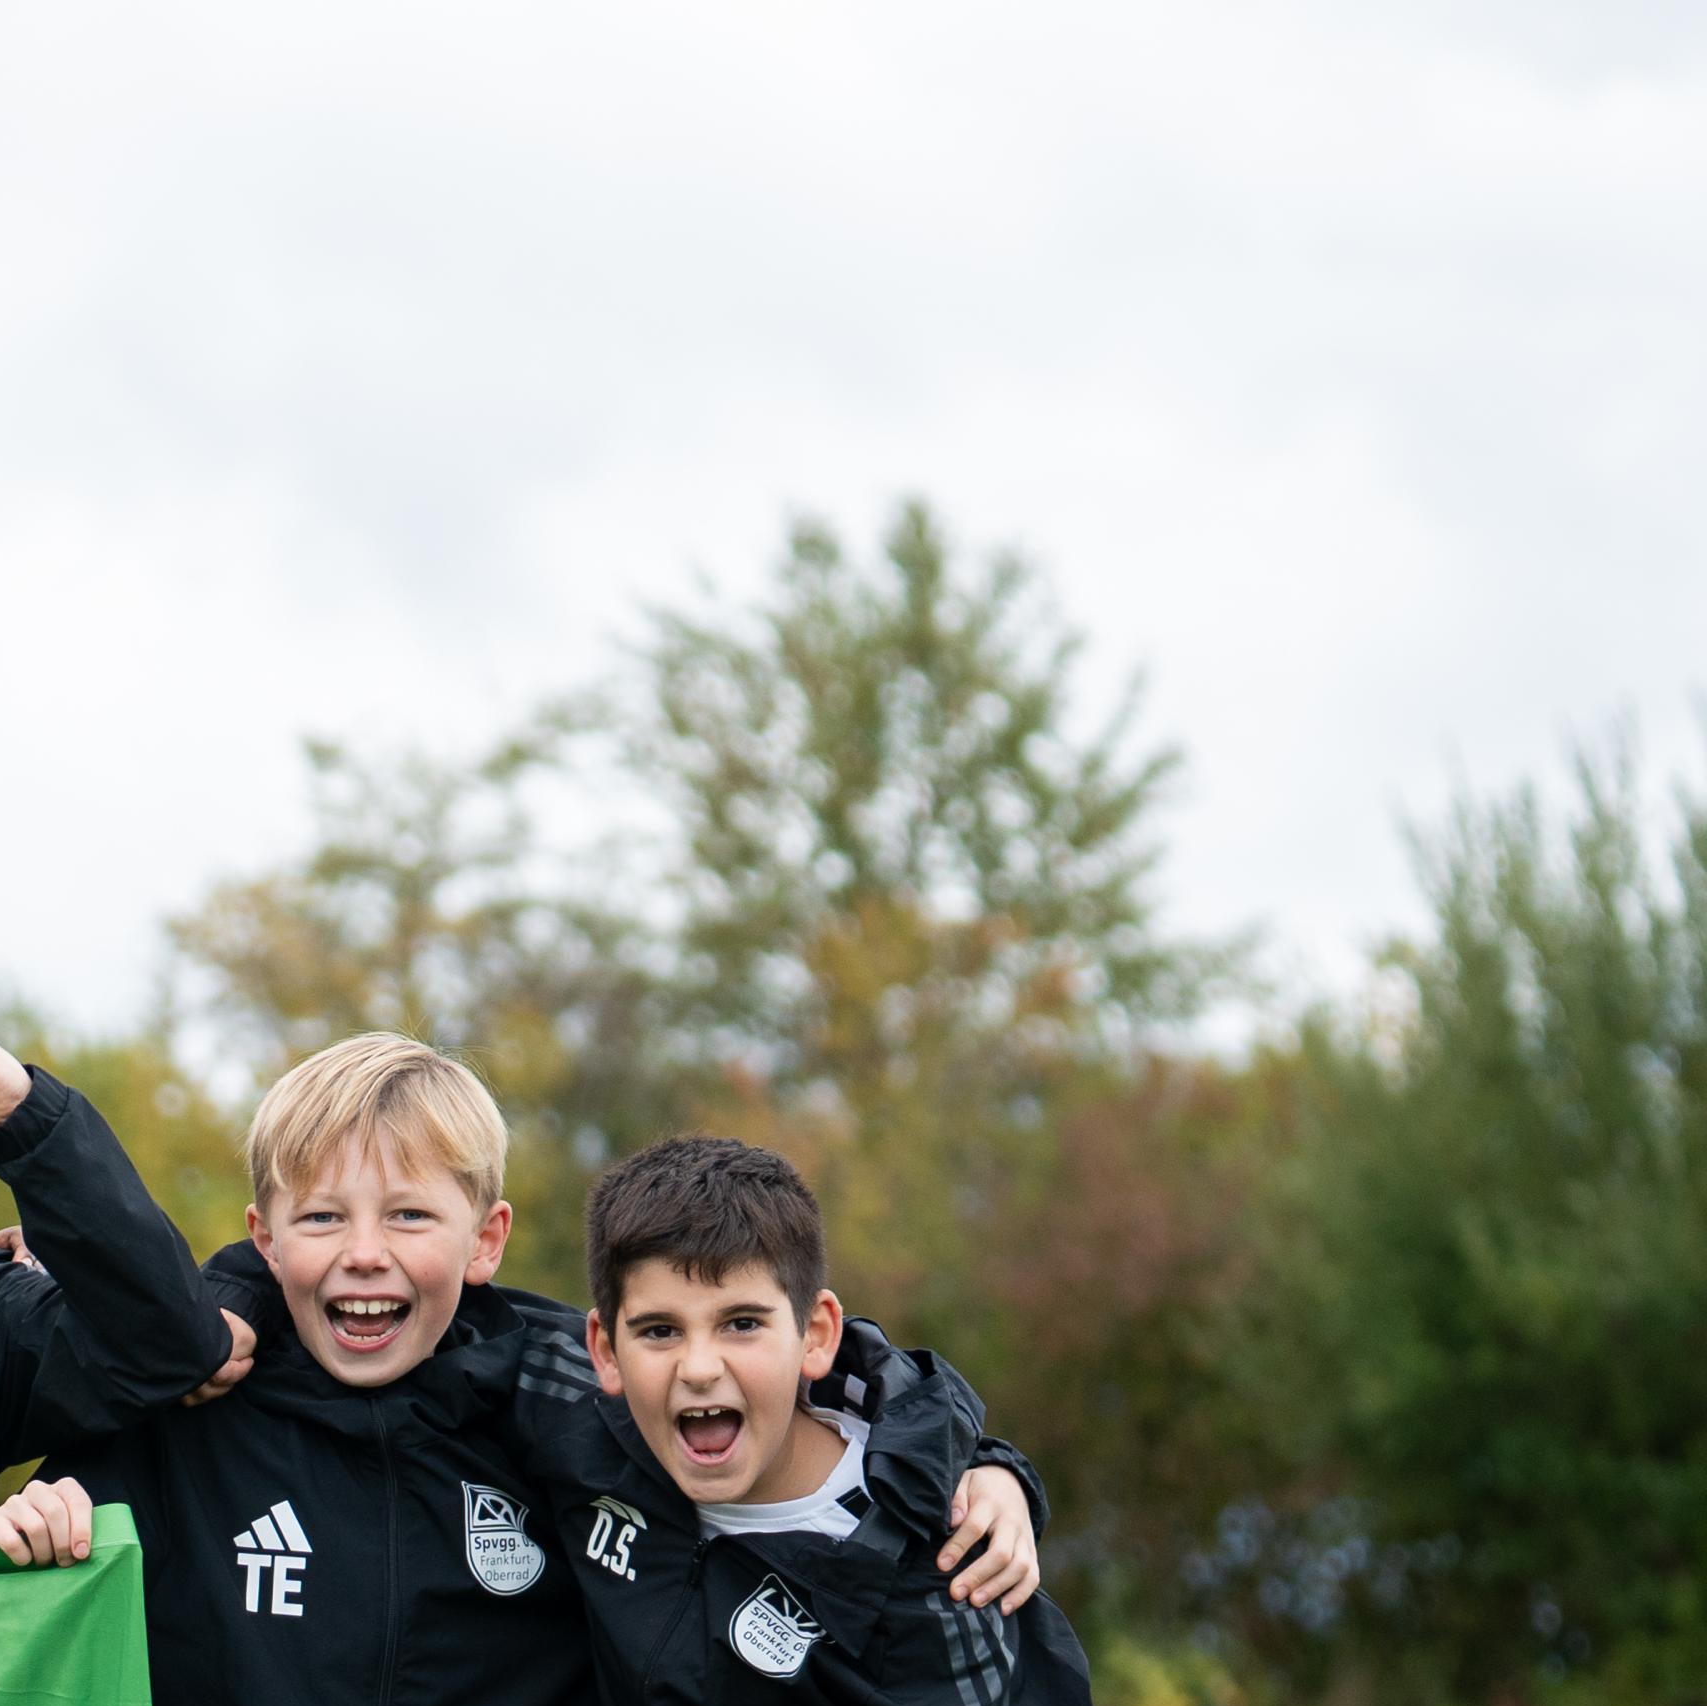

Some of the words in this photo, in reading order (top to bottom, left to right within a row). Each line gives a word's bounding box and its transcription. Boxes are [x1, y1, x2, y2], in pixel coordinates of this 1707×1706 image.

[474, 1536, 520, 1553] Spvgg.
[480, 1553, 535, 1566] Frankfurt-
[586, 1508, 637, 1581] D.S.
[237, 1552, 306, 1616] TE
[484, 1568, 530, 1581] Oberrad
[747, 1620, 795, 1662] Frankfurt
[750, 1606, 791, 1645] SPVGG.
[743, 1630, 785, 1666] Oberrad
